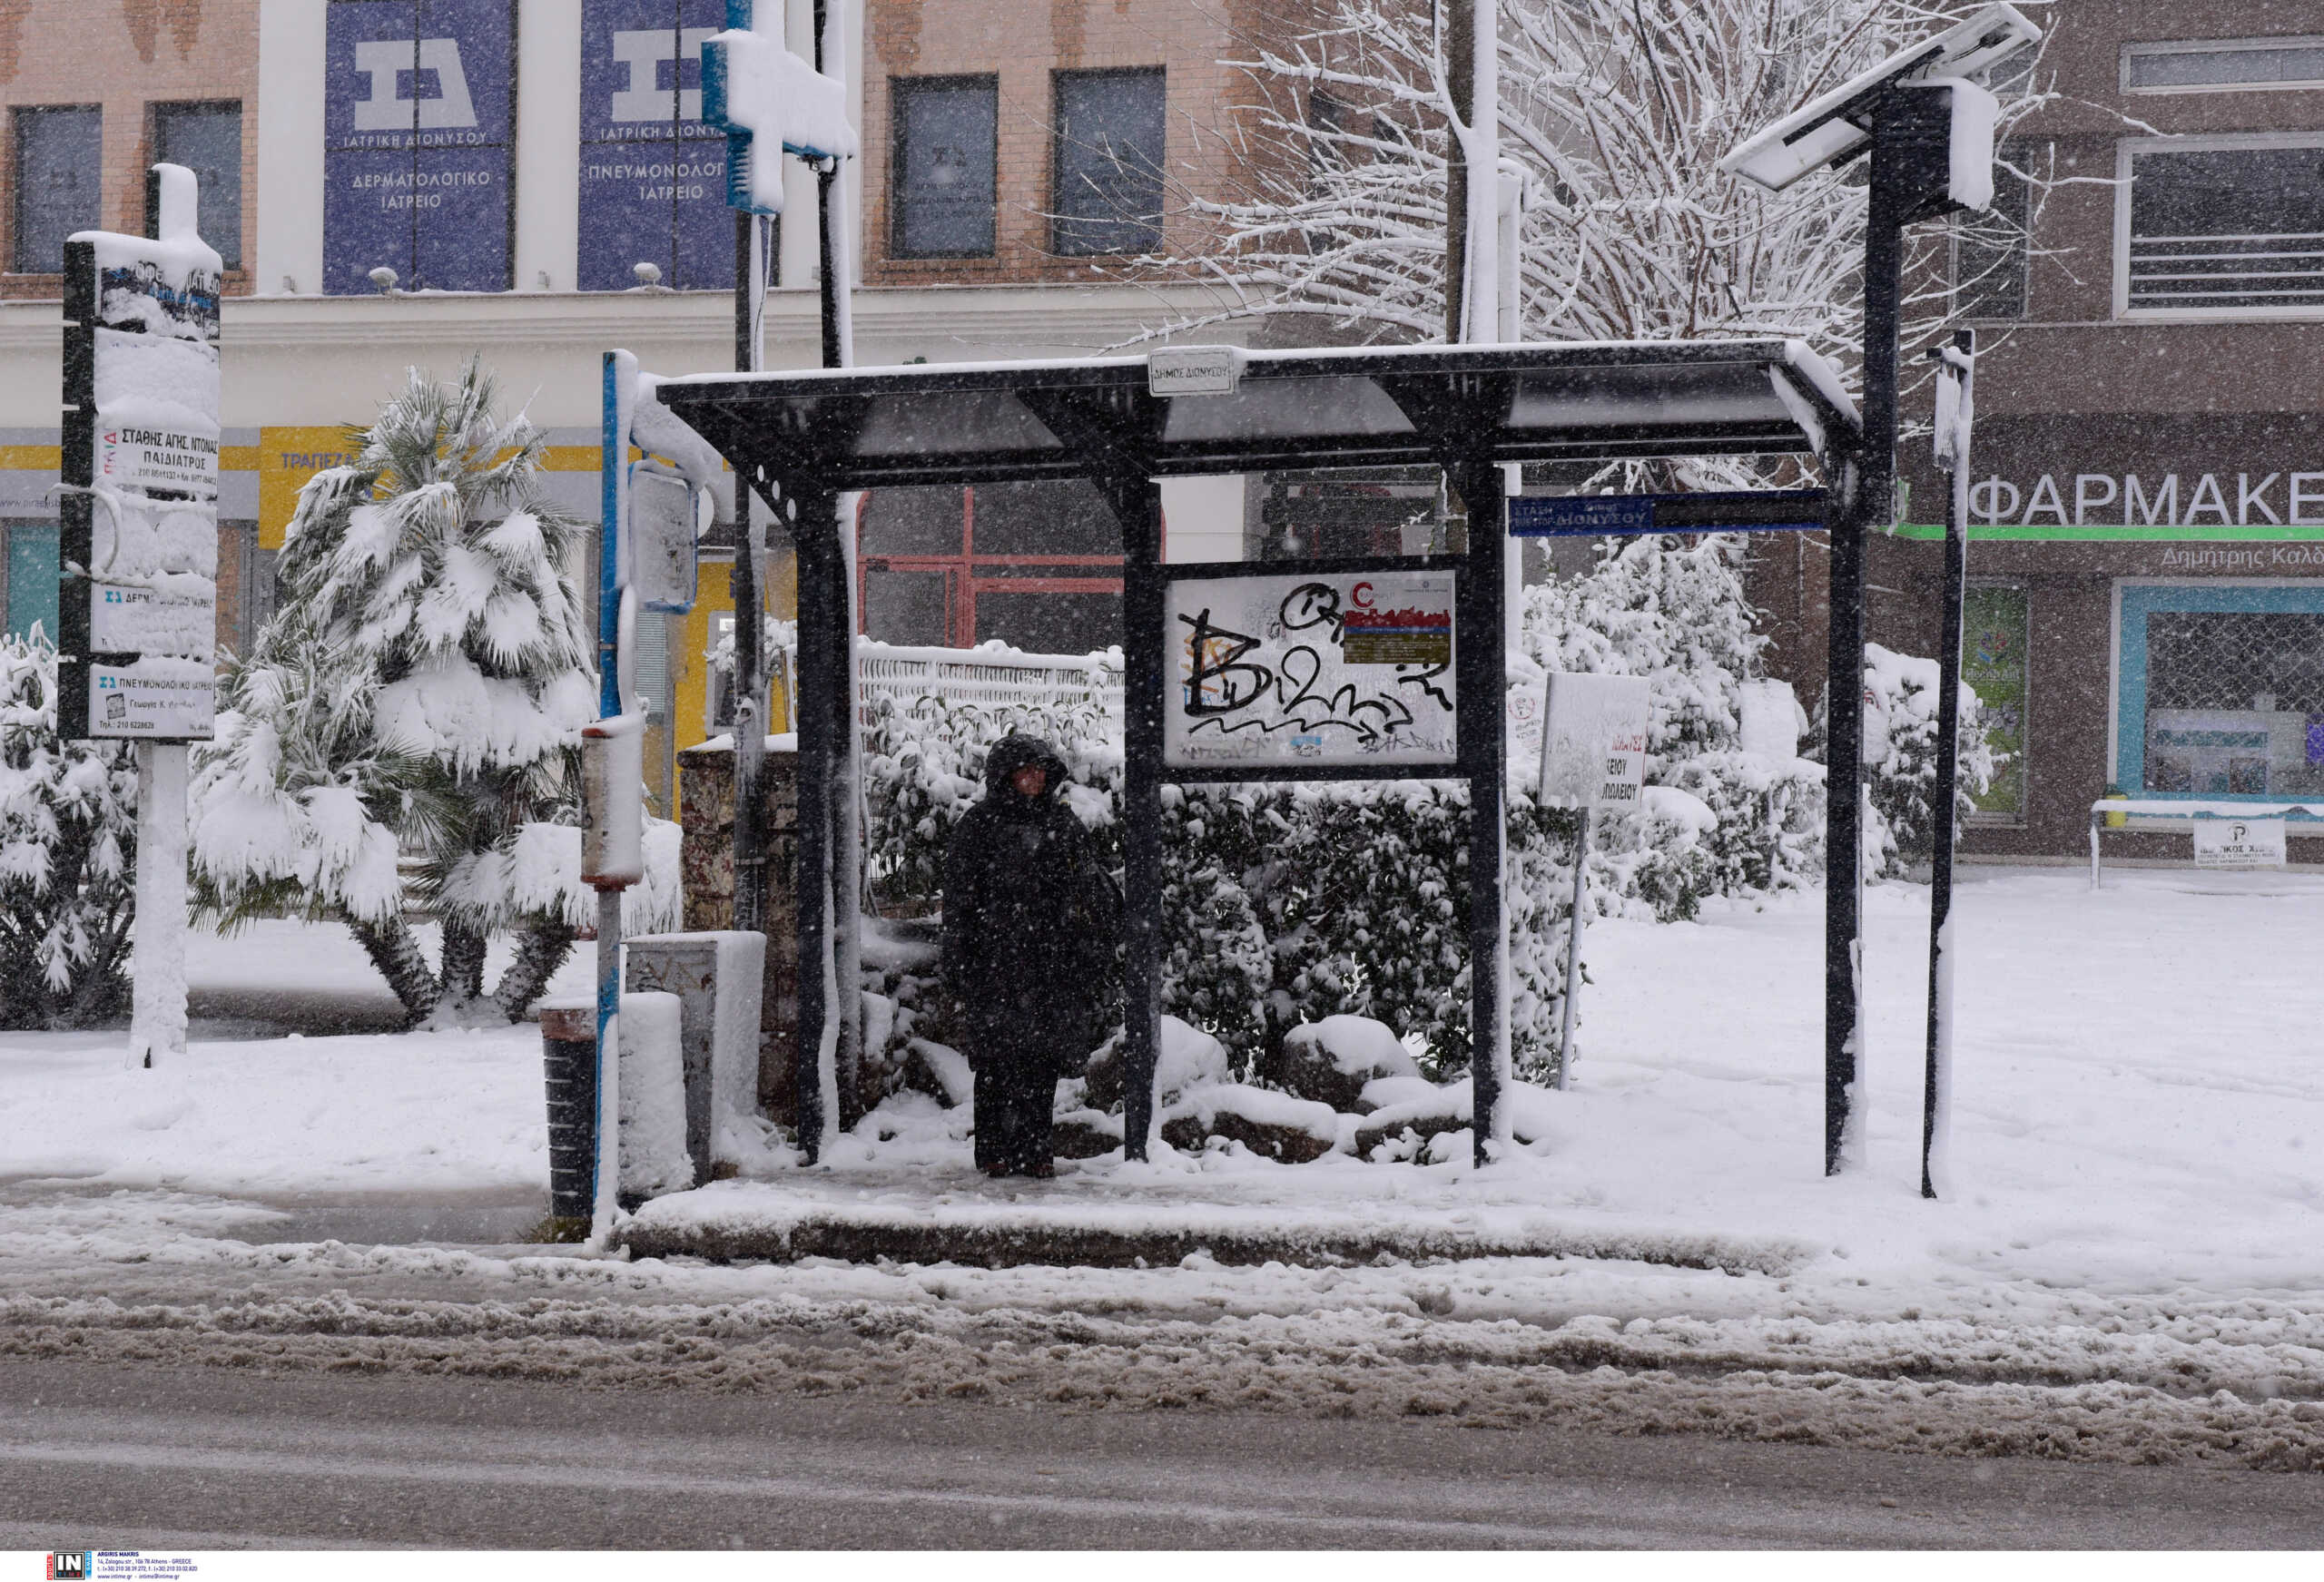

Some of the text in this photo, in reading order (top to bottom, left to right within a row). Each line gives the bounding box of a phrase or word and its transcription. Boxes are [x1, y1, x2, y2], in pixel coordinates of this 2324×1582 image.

[600, 124, 726, 139] ΙΑΤΡΙΚΗ ΔΙΟΝΥ
[343, 132, 487, 147] ΙΑΤΡΙΚΗ ΔΙΟΝΥΣΟΥ
[588, 162, 725, 180] ΠΝΕΥΜΟΝΟΛΟΓ
[351, 172, 491, 189] ΔΕΡΜΑΤΟΛΟΓΙΚΟ
[640, 185, 704, 200] ΙΑΤΡΕΙΟ
[381, 194, 442, 209] ΙΑΤΡΕΙΟ
[1154, 366, 1227, 378] ΔΗΜΟΣ ΔΙΟΝΥΣΟΥ
[122, 428, 163, 447] ΣΤΑΘΗΣ
[143, 451, 206, 470] ΠΑΙΔΙΑΤΡΟΣ
[1968, 472, 2324, 526] ΦΑΡΜΑΚΕ
[1556, 512, 1648, 526] ΔΙΟΝΥΣΟΥ
[117, 721, 128, 729] 210
[1601, 782, 1638, 801] ΠΩΛΕΙΟΥ
